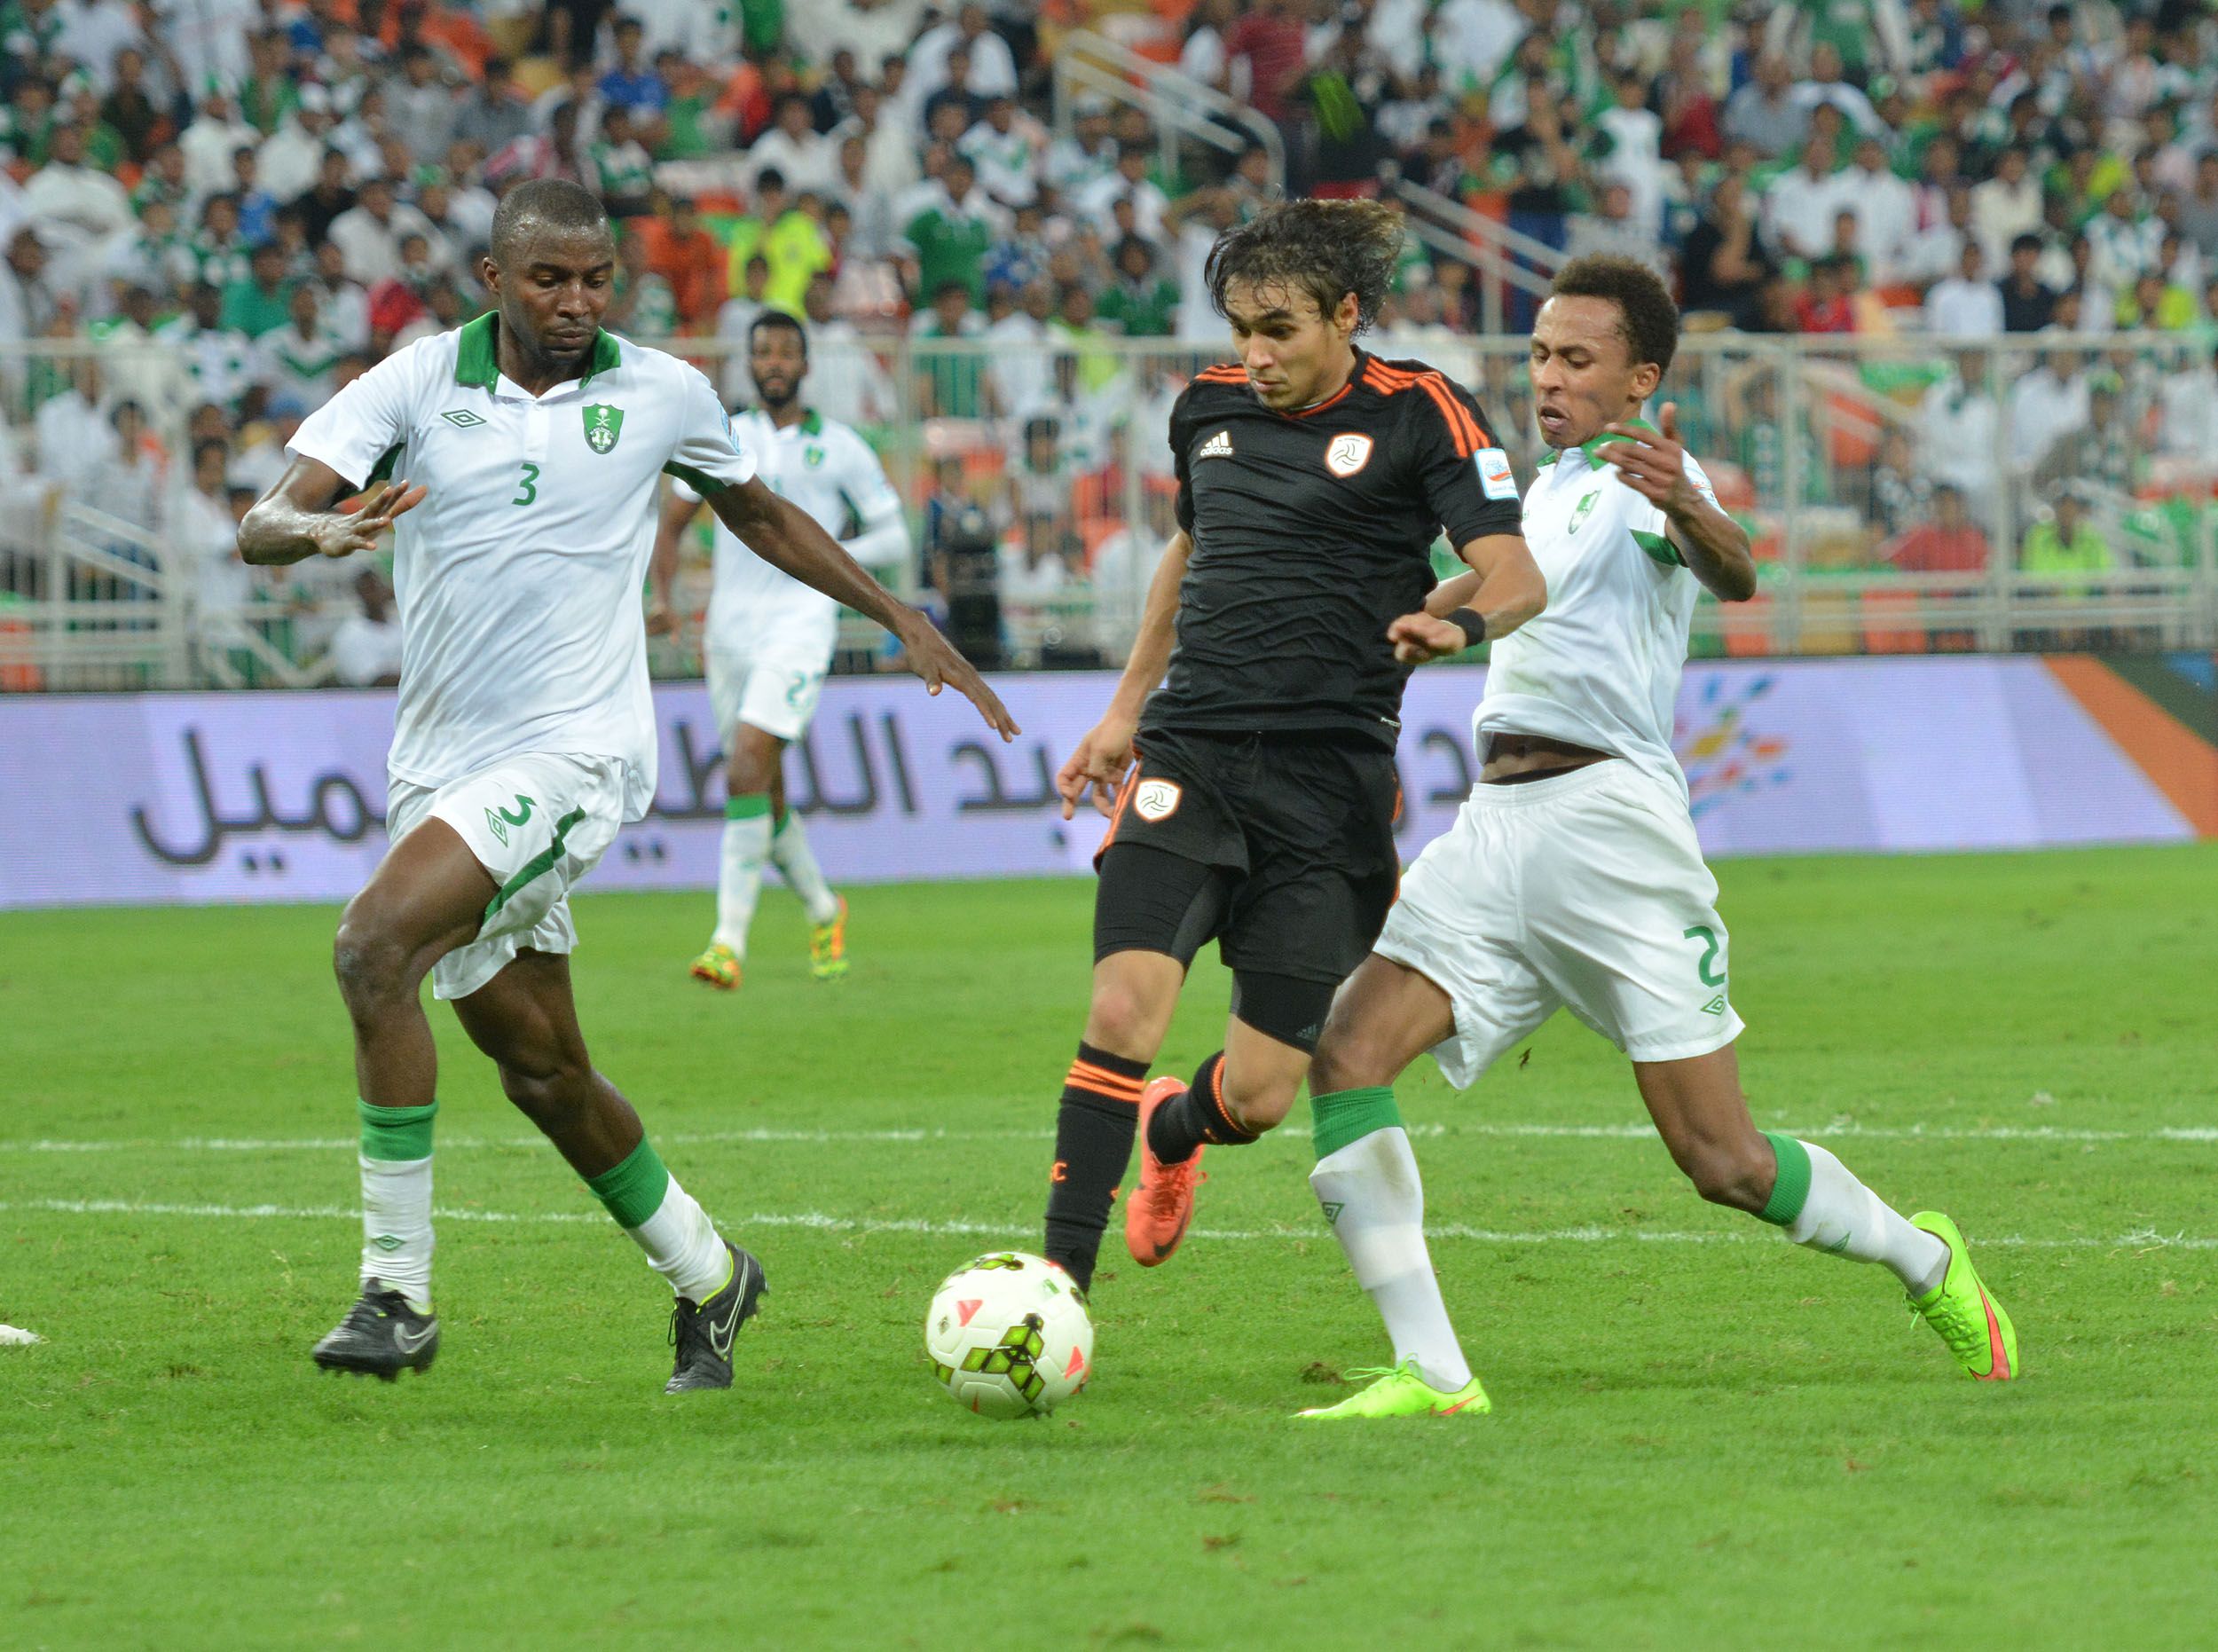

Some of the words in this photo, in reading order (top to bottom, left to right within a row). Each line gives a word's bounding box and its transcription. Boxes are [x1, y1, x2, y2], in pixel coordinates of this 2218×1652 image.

[1199, 445, 1234, 457] adidas
[511, 461, 540, 507] 3
[130, 726, 388, 870] ميل
[949, 740, 1114, 850] بد
[1682, 924, 1726, 988] 2
